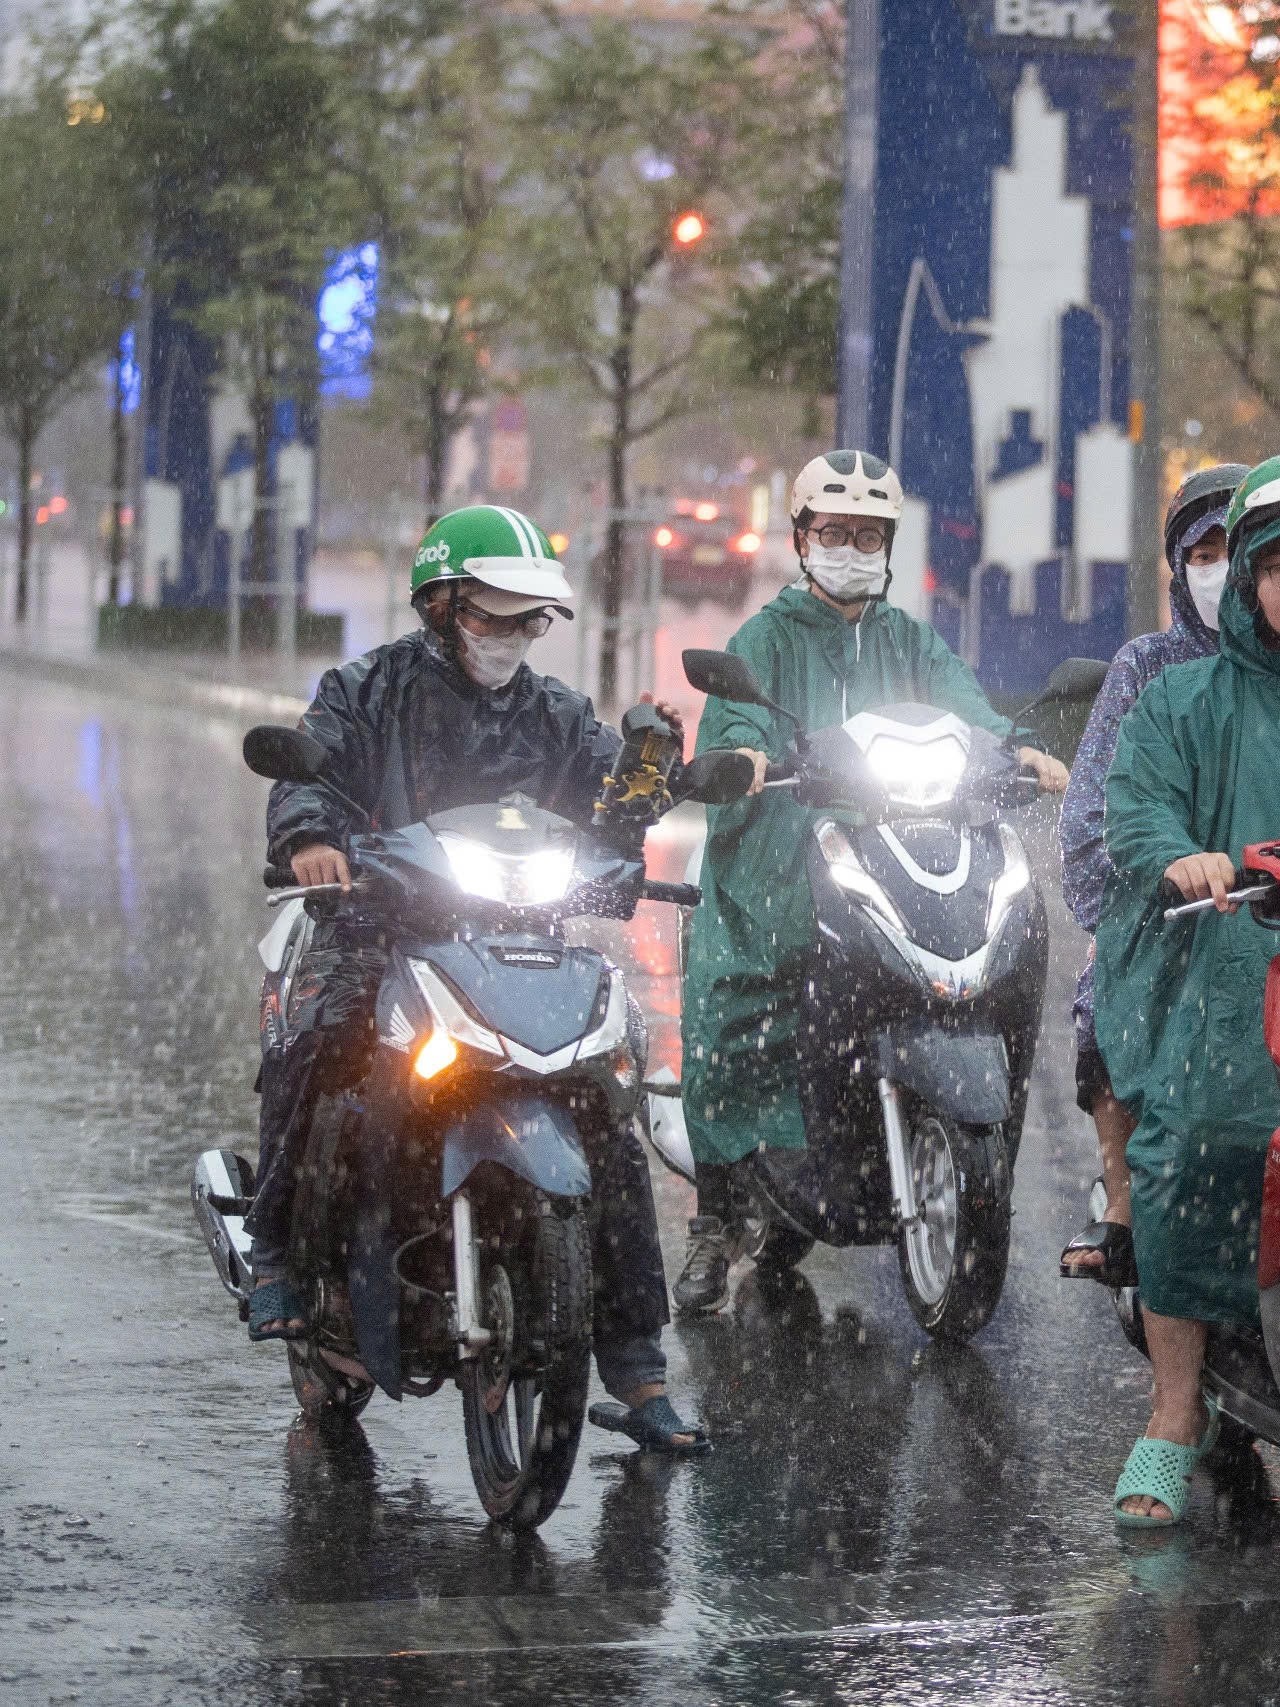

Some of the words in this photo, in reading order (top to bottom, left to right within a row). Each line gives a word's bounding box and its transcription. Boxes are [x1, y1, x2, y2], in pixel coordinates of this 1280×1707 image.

[995, 0, 1114, 41] Bank
[415, 540, 450, 567] Grab
[504, 954, 556, 963] HONDA
[263, 994, 277, 1048] FUTUR
